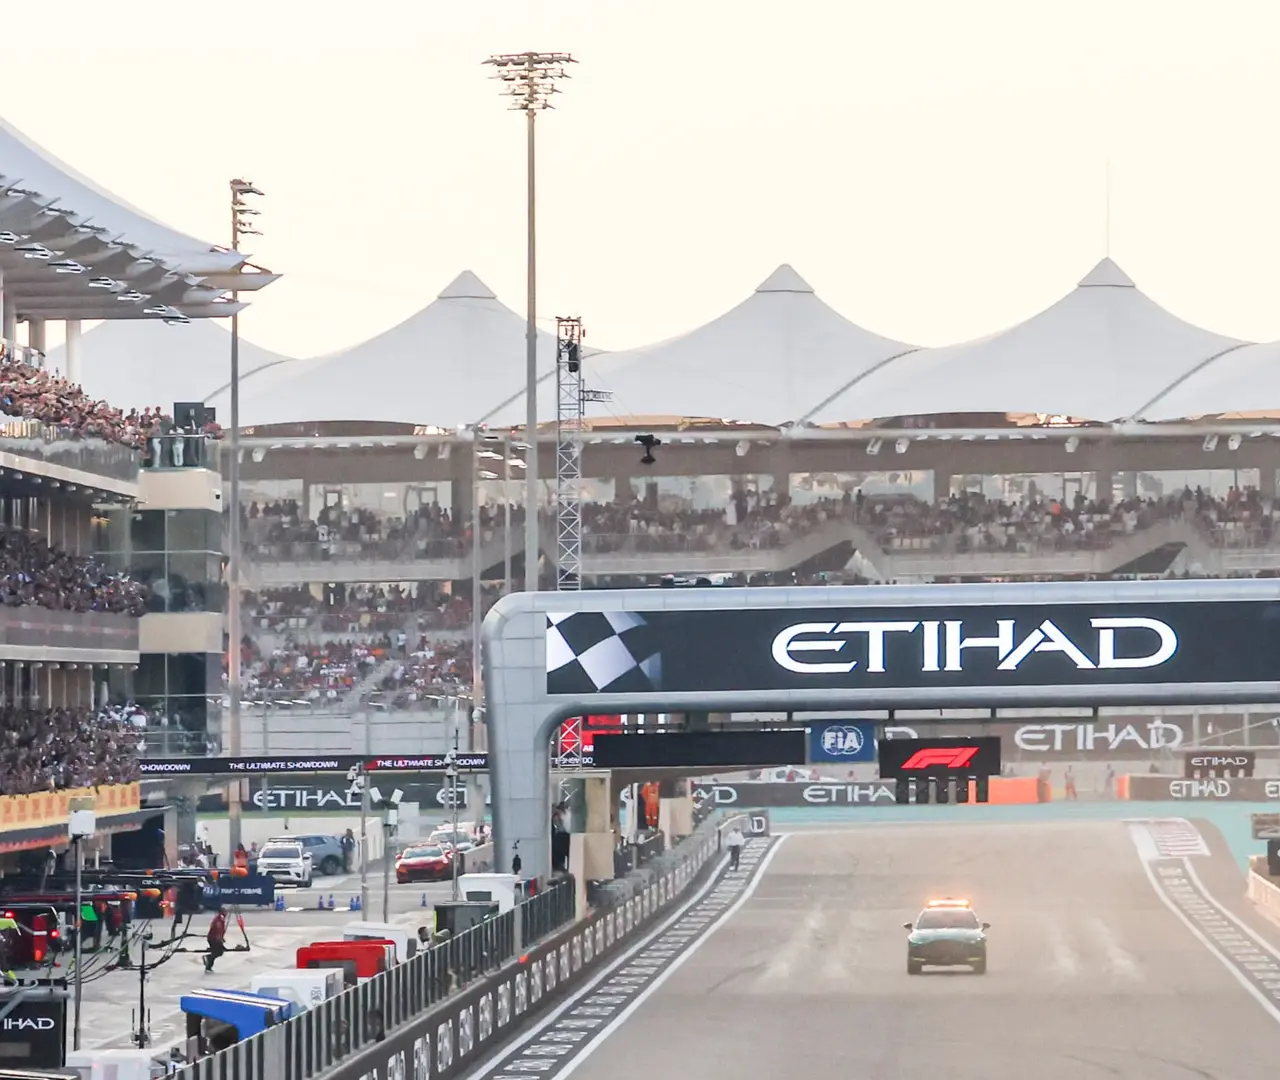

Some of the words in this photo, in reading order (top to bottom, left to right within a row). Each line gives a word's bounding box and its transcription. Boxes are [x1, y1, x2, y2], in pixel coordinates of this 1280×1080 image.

[771, 617, 1178, 674] ETIHAD
[1014, 723, 1184, 750] ETIHAD
[228, 762, 244, 770] THE
[246, 762, 286, 770] ULTIMATE
[287, 760, 338, 769] SHOWDOWN
[434, 758, 485, 766] SHDOWN
[1190, 756, 1248, 766] ETIHAD
[1170, 780, 1230, 798] ETIHAD
